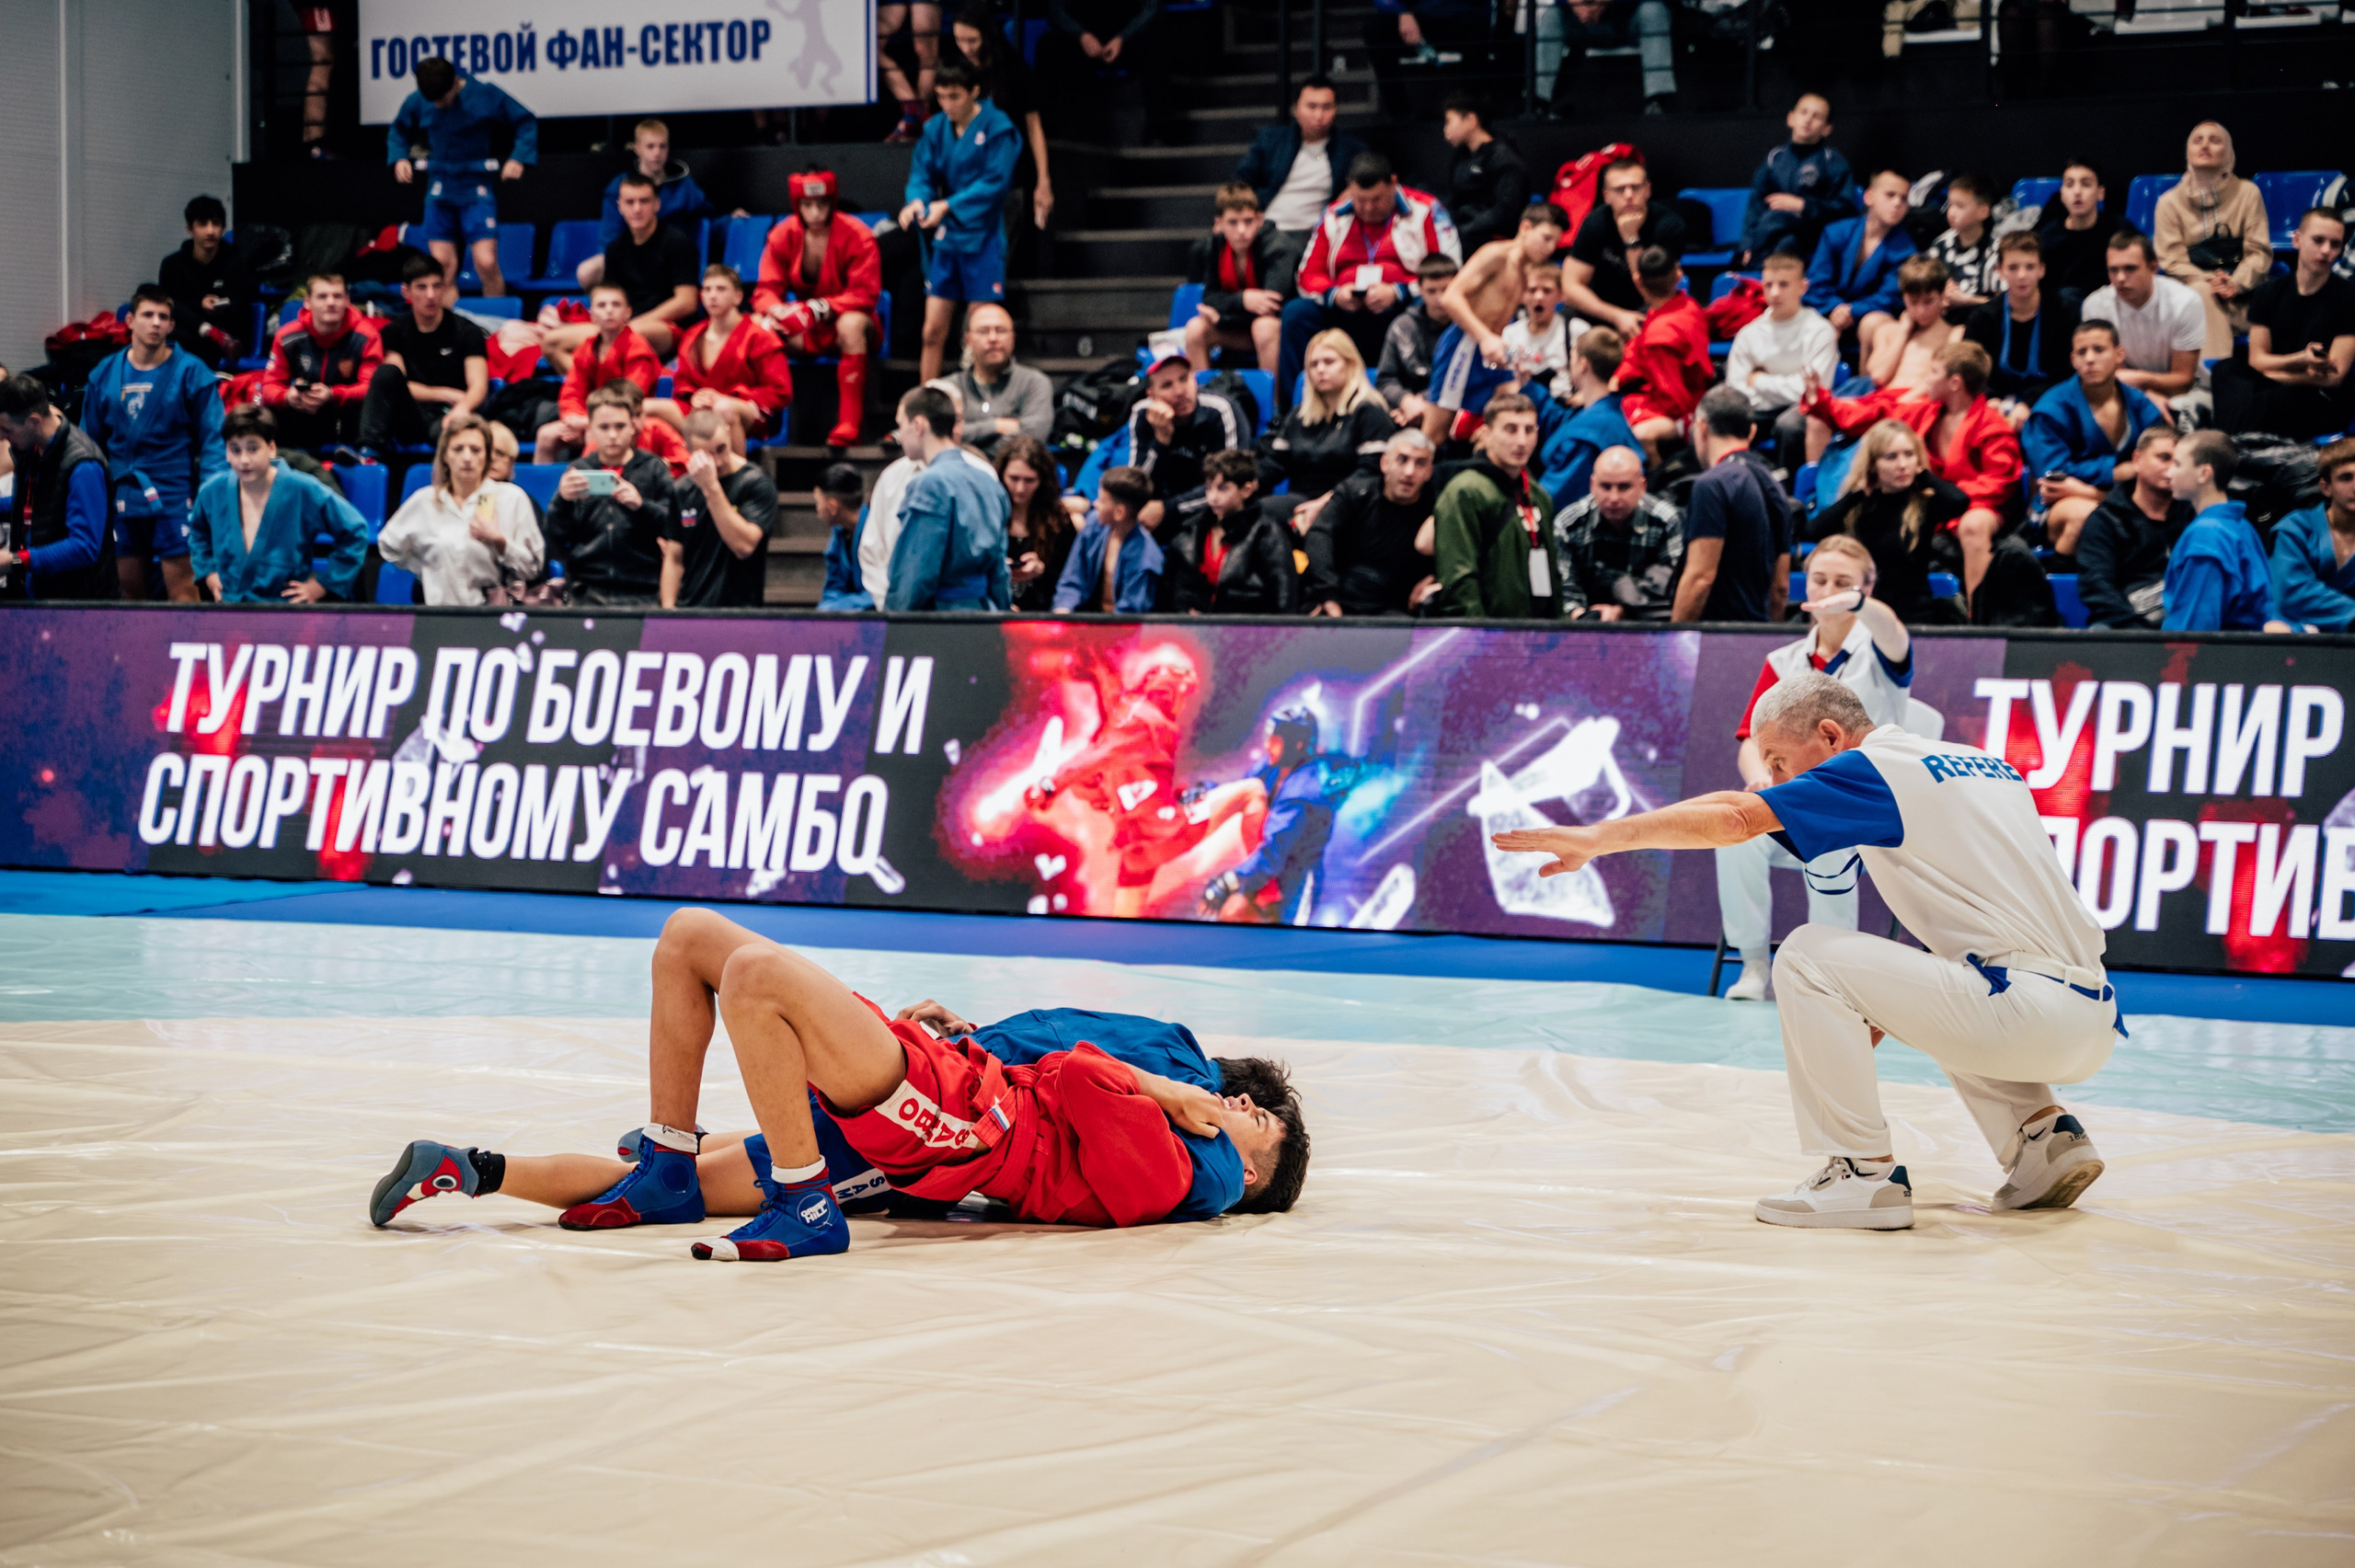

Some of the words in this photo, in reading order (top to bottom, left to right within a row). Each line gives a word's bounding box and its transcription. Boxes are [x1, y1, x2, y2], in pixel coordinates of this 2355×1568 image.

[371, 21, 536, 80] ГОСТЕВОЙ
[546, 19, 770, 71] ФАН-СЕКТОР
[166, 642, 419, 738] ТУРНИР
[422, 647, 521, 743] ПО
[525, 648, 869, 752] БОЕВОМУ
[874, 656, 935, 754] И
[1973, 678, 2345, 797] ТУРНИР
[138, 751, 634, 863] СПОРТИВНОМУ
[638, 770, 889, 876] САМБО
